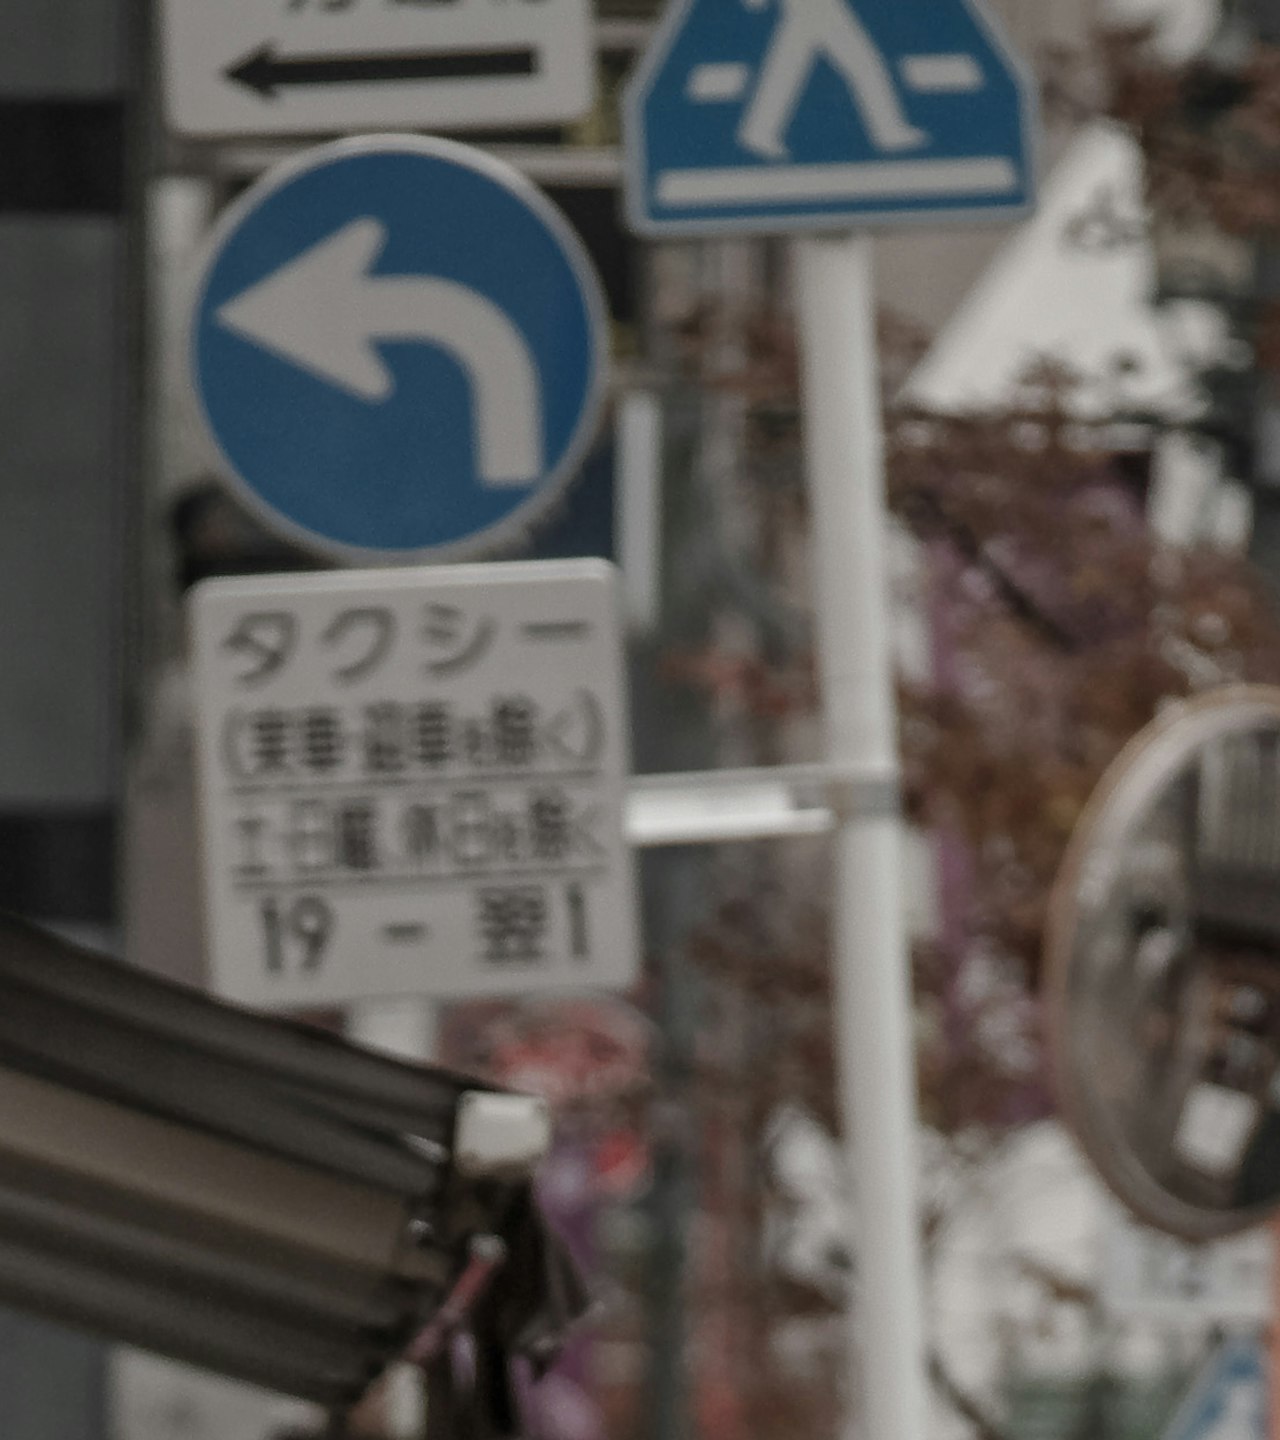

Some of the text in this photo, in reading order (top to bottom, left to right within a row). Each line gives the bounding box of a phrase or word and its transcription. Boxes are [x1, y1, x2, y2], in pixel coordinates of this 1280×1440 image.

[223, 601, 588, 685] タクシー
[259, 893, 334, 975] 19
